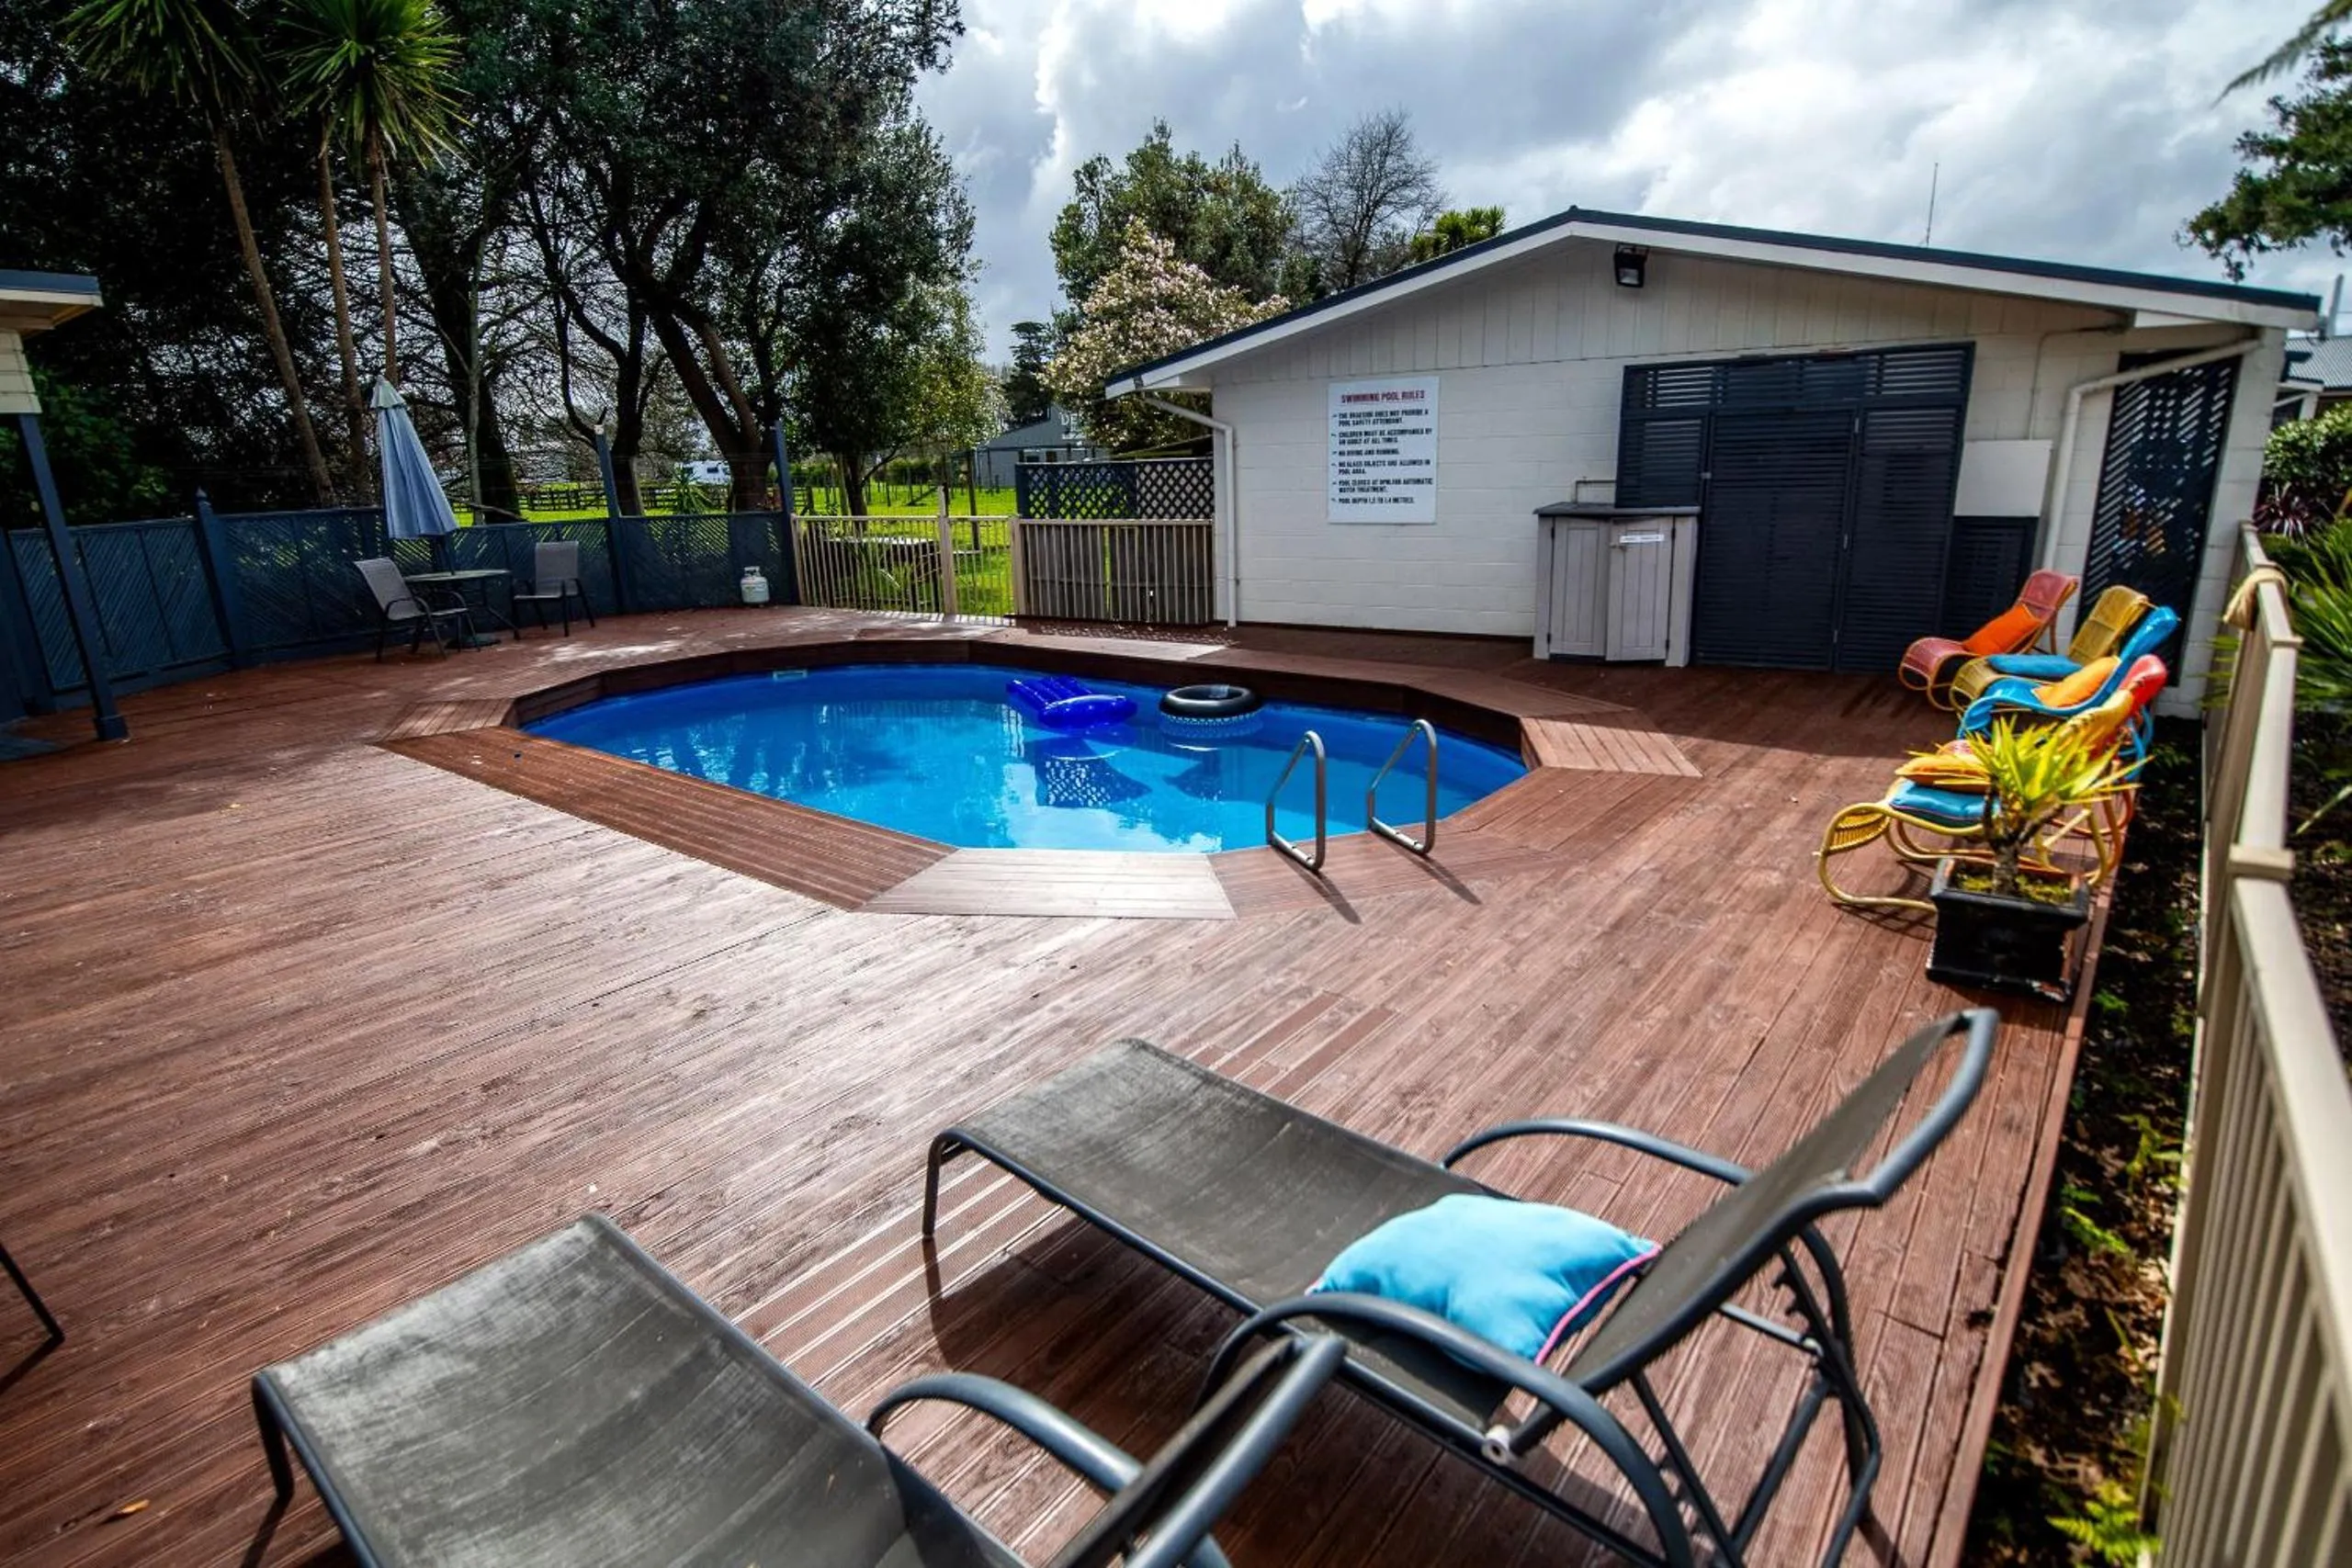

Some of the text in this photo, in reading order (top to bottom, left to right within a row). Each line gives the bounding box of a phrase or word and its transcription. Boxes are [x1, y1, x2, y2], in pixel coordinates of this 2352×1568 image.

[1342, 391, 1424, 403] SWIMMING POOL RULES
